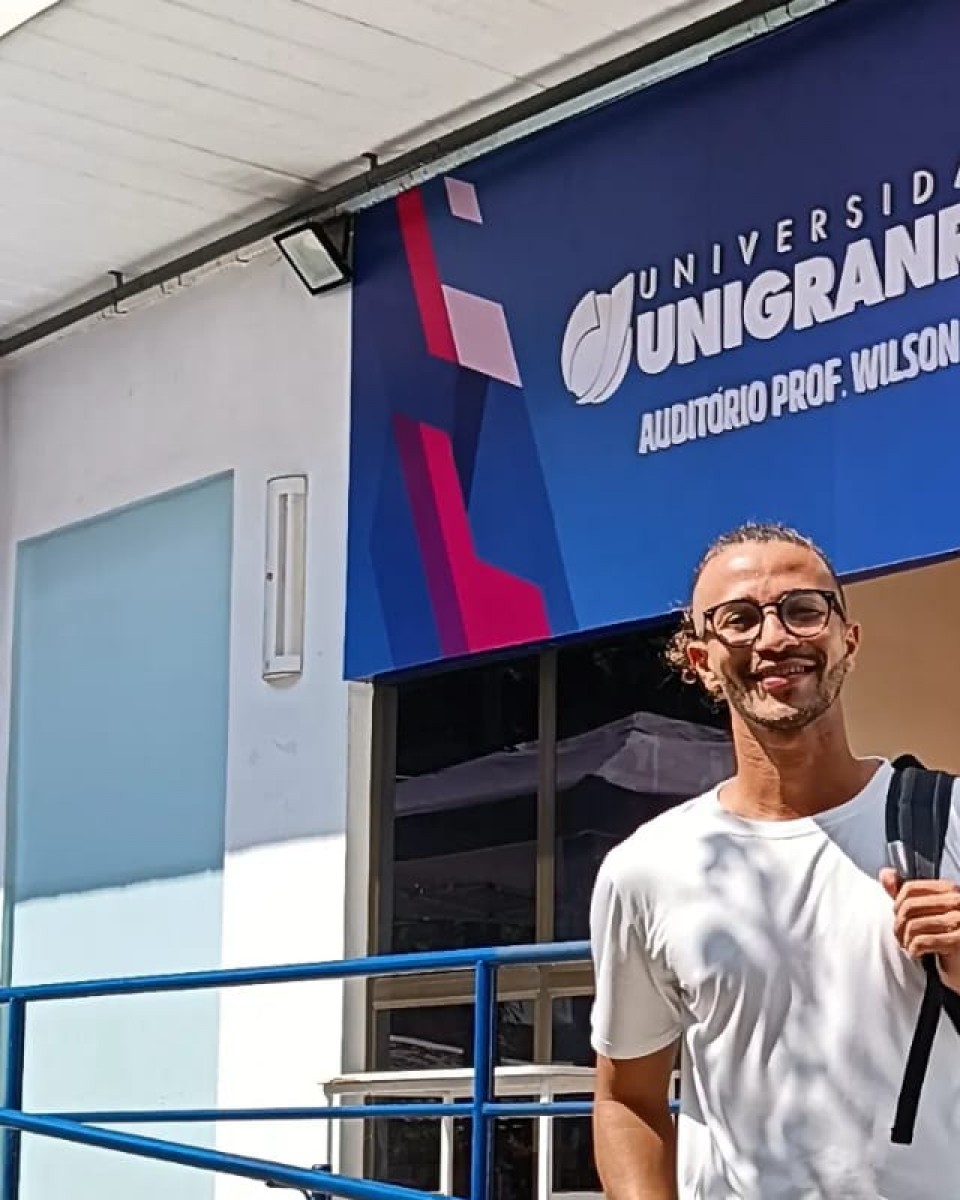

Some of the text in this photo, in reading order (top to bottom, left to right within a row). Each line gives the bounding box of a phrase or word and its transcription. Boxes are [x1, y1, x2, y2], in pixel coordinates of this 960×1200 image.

[638, 380, 768, 454] AUDITÓRIO
[771, 357, 848, 418] PROF.
[850, 318, 960, 394] WILSON
